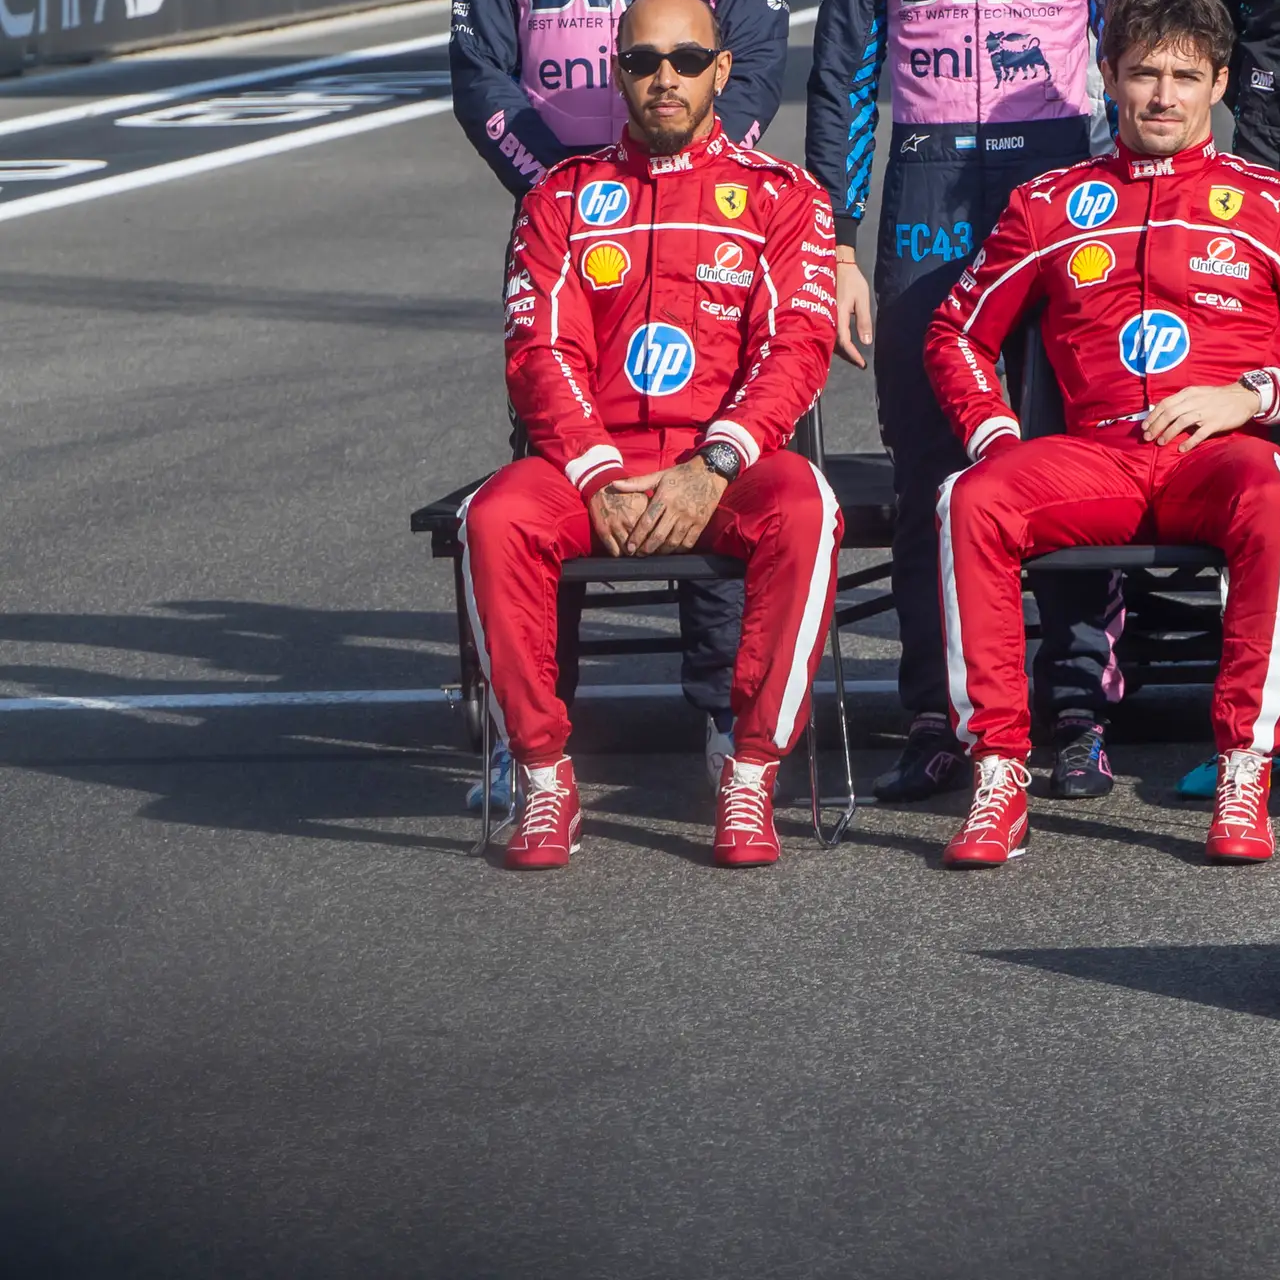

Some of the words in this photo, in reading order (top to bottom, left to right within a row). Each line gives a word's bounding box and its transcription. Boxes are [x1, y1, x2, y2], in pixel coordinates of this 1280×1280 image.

[558, 18, 603, 29] WATER
[926, 9, 969, 20] WATER
[975, 6, 1063, 19] TECHNOLOGY
[540, 46, 606, 89] eni
[910, 36, 972, 78] eni
[986, 136, 1024, 150] FRANCO
[650, 153, 692, 174] IBM
[1132, 157, 1173, 176] IBM
[588, 182, 620, 224] hp
[1079, 183, 1112, 228] hp
[895, 222, 973, 262] FC43
[698, 265, 753, 287] UniCredit
[1190, 258, 1249, 279] UniCredit
[700, 301, 741, 317] CEVA
[1195, 292, 1242, 308] CEVA
[1129, 311, 1181, 373] hp
[634, 323, 686, 395] hp
